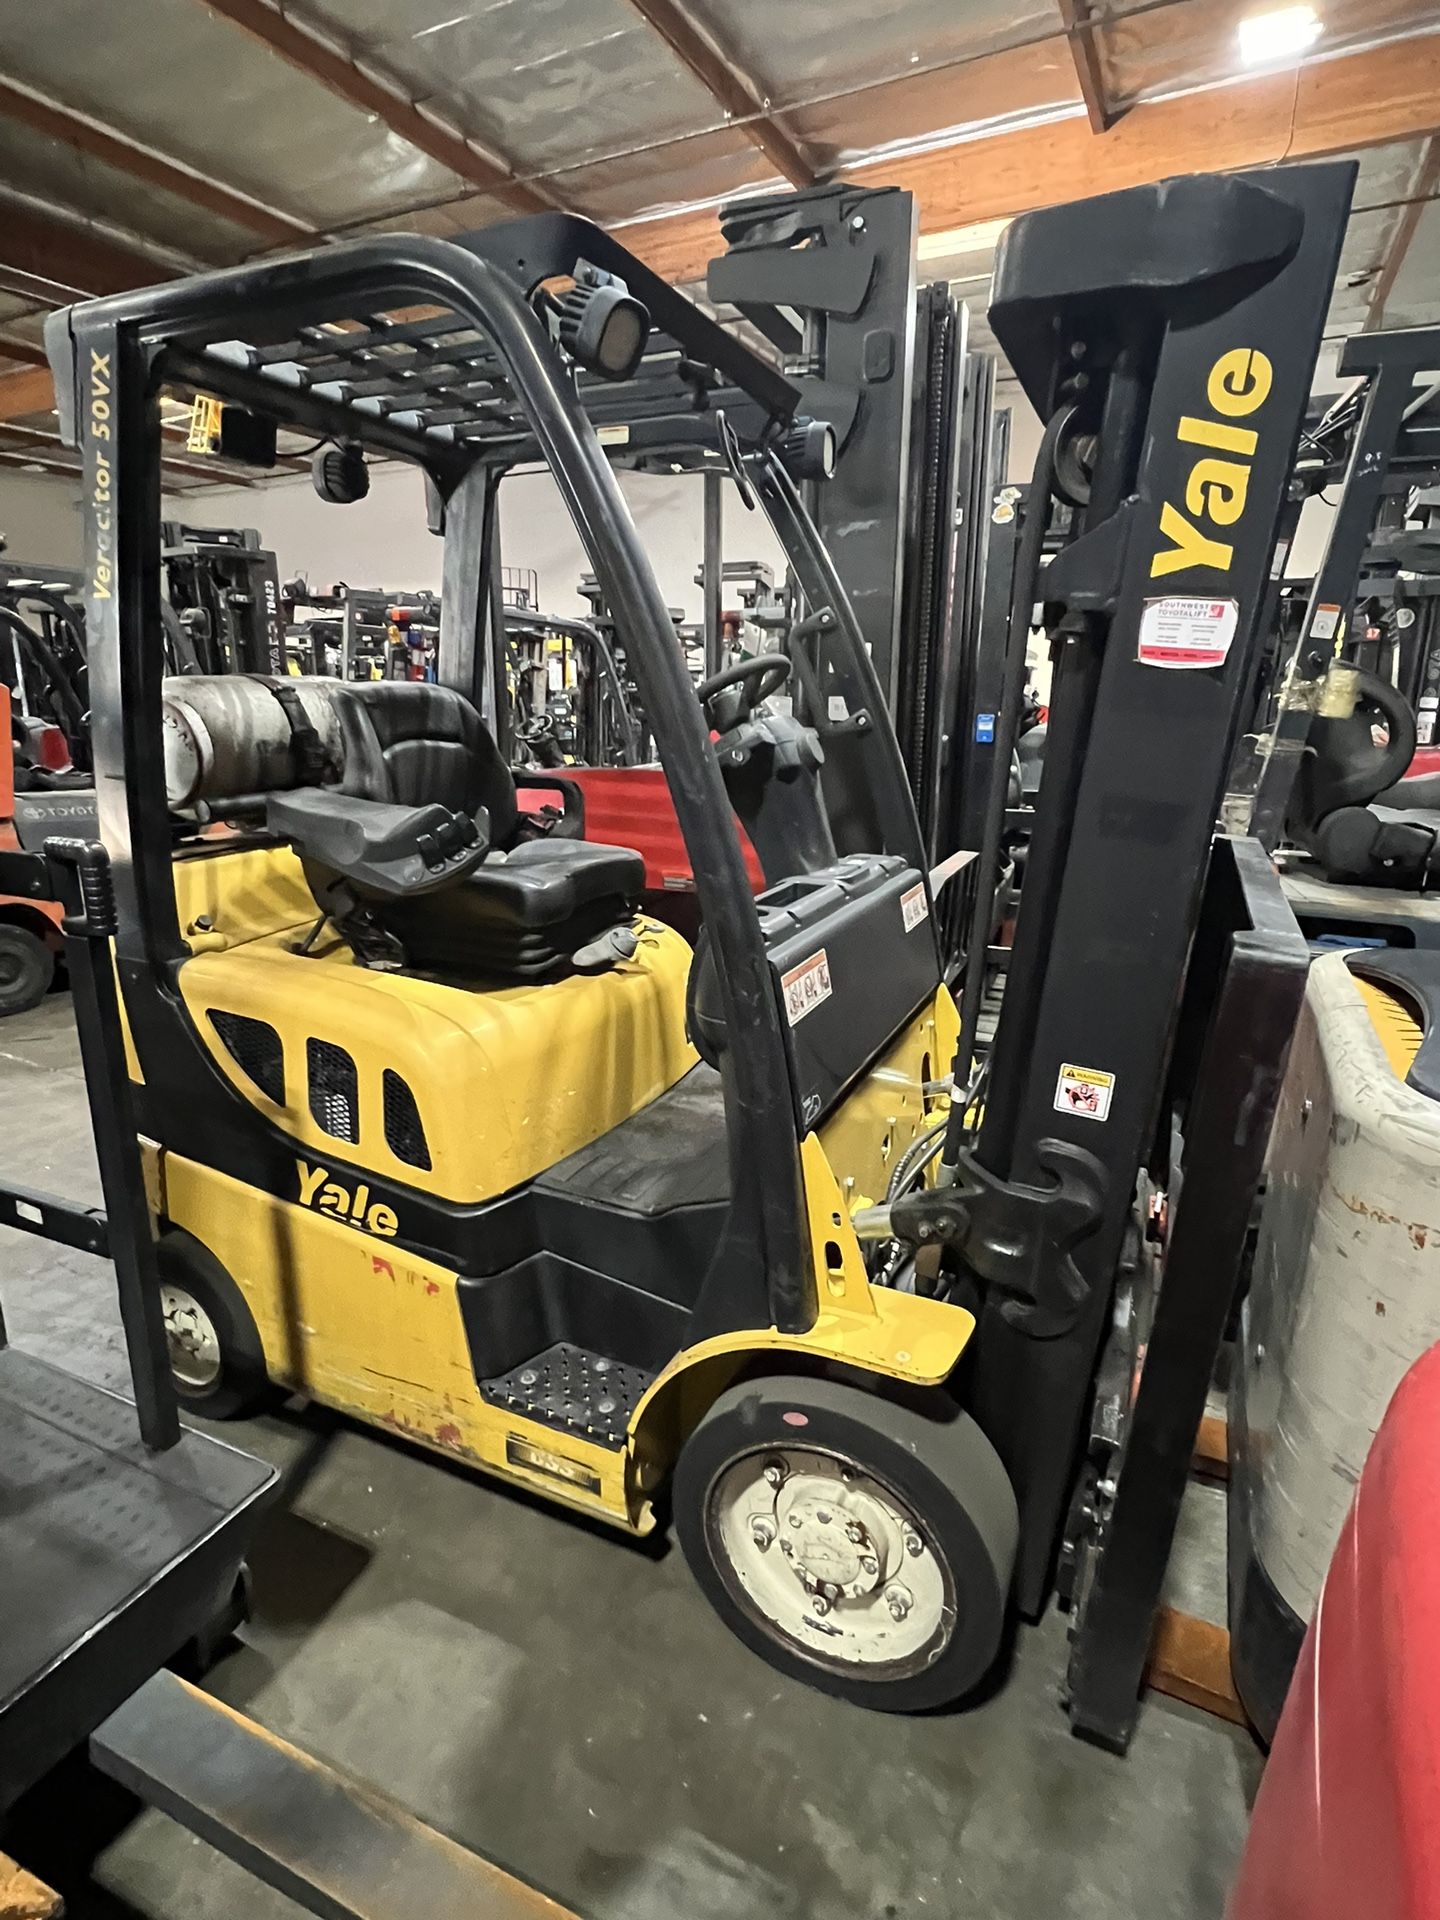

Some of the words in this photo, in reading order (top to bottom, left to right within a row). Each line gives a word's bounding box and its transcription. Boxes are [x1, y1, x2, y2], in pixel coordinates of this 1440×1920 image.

[91, 347, 111, 441] 50VX
[1150, 347, 1273, 578] Yale
[91, 450, 111, 598] Veracitor
[47, 806, 97, 816] TOYOT
[296, 1159, 399, 1237] Yale
